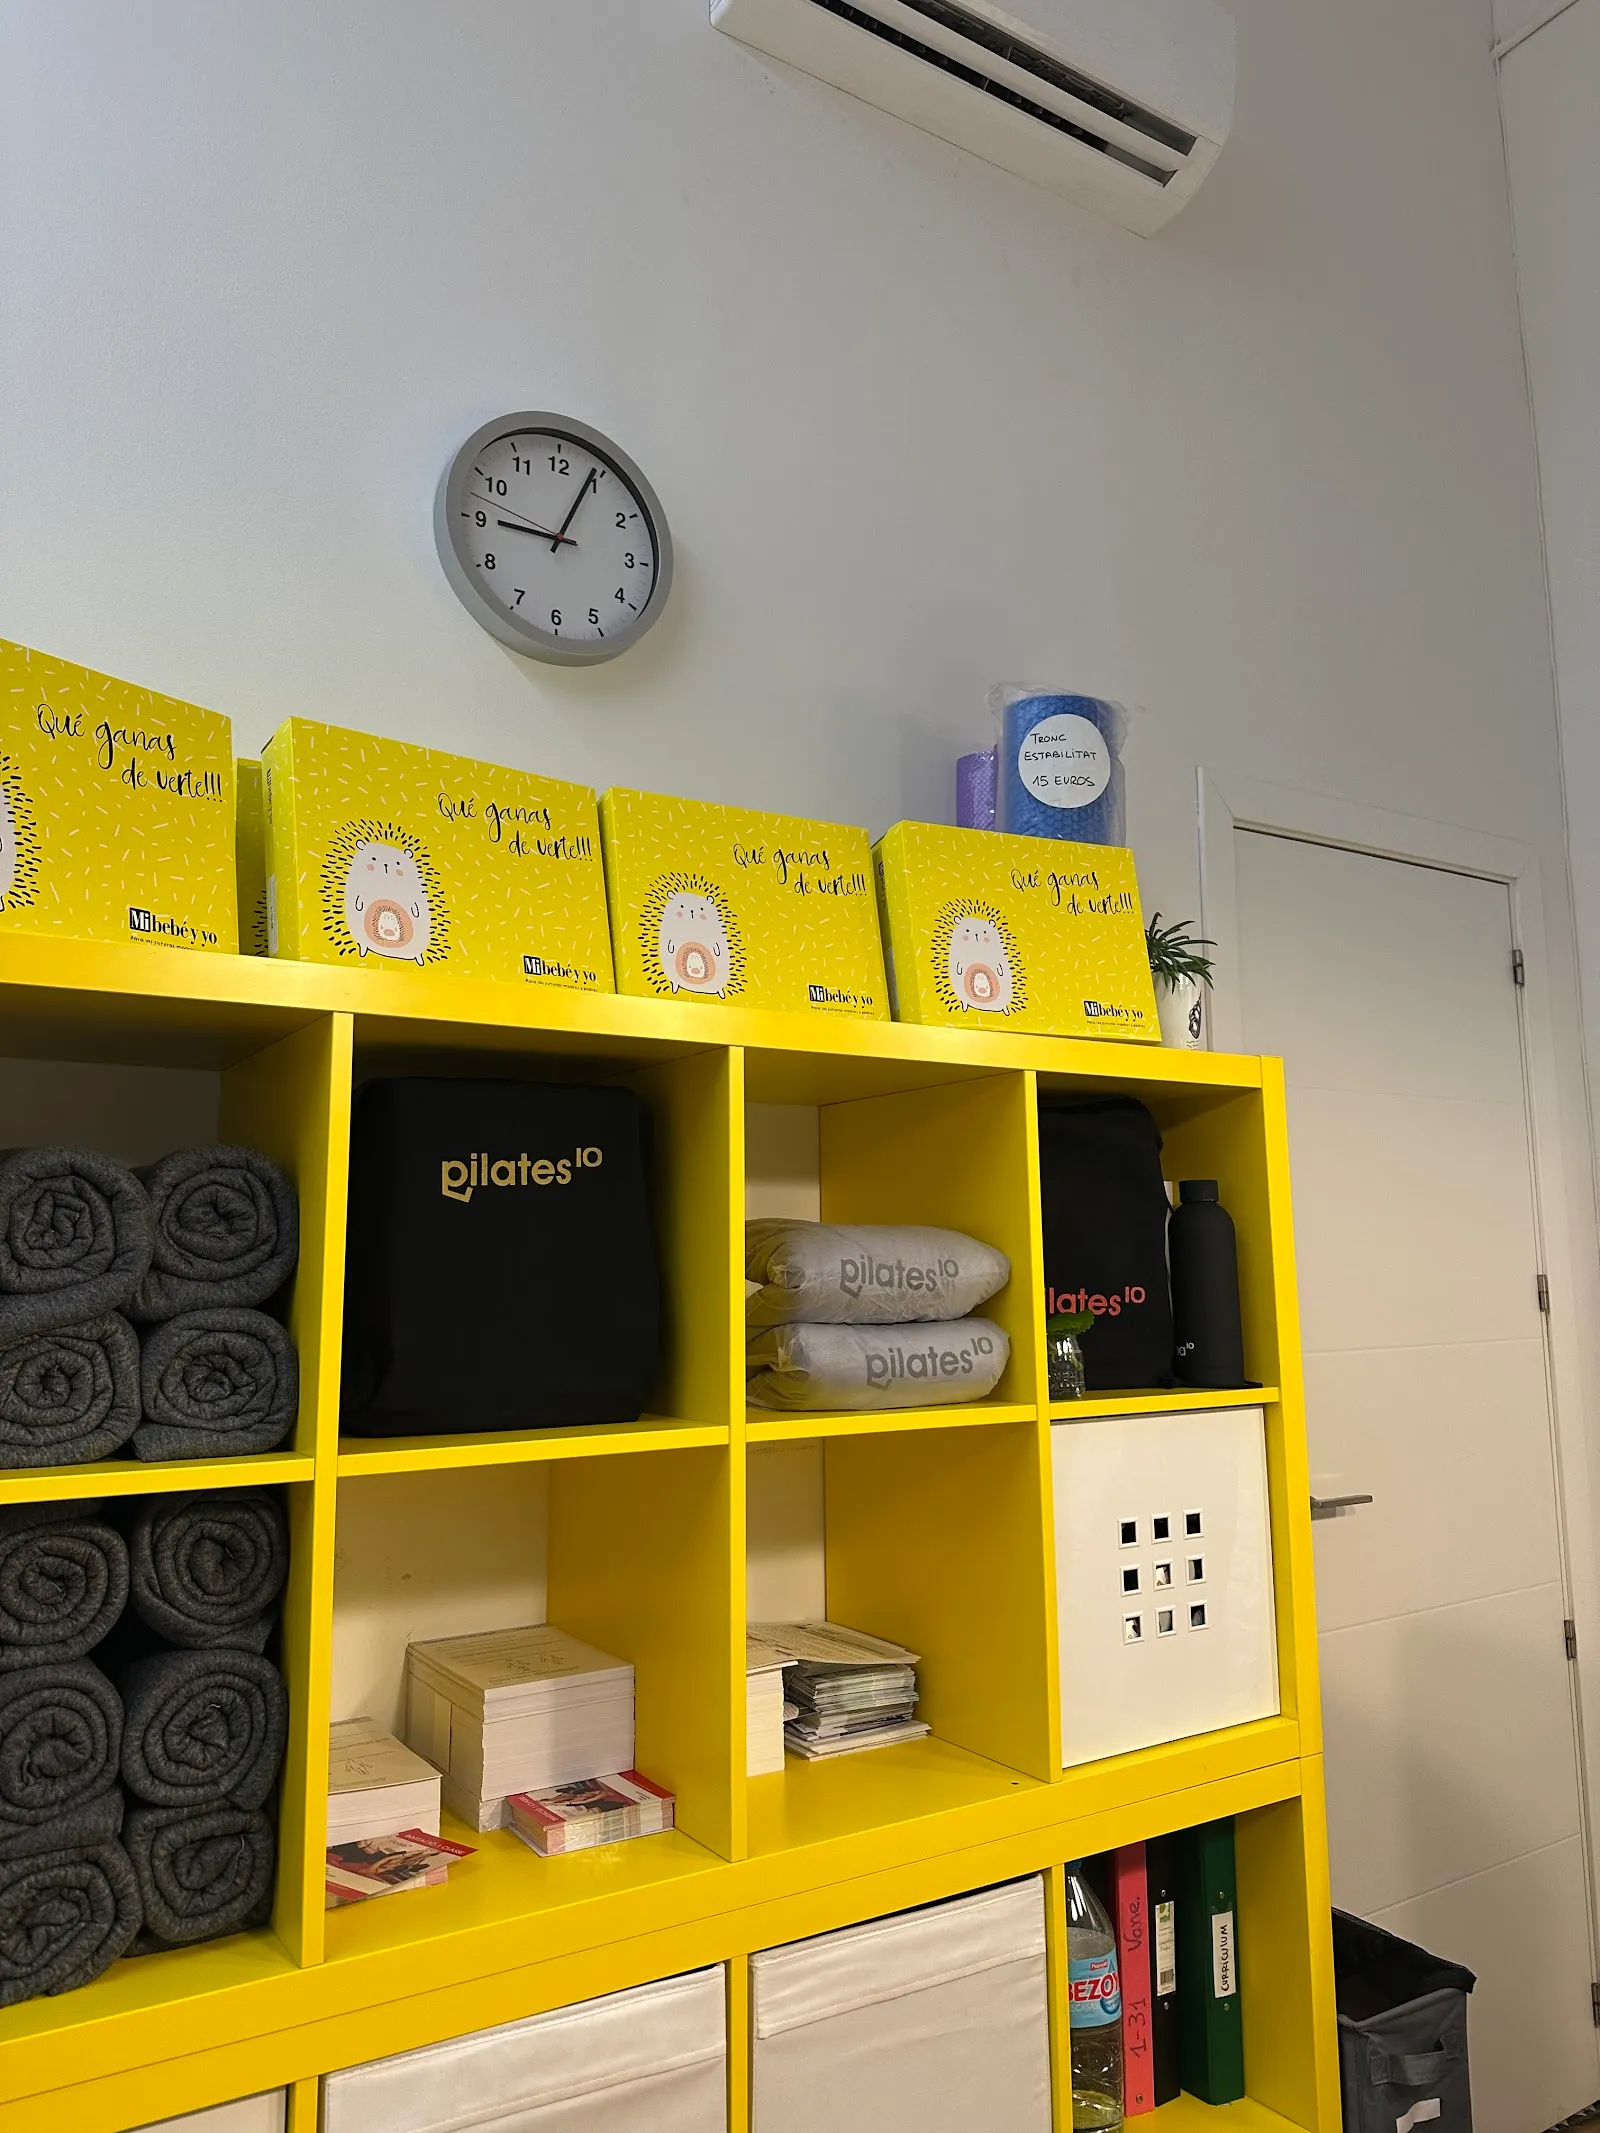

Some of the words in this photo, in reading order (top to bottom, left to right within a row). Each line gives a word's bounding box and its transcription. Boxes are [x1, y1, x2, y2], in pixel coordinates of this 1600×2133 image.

[512, 456, 531, 476] 11
[548, 456, 570, 476] 12
[485, 476, 508, 497] 10
[475, 510, 487, 528] 9
[615, 512, 627, 529] 2
[484, 553, 497, 570] 8
[624, 552, 635, 569] 3
[513, 588, 526, 606] 7
[614, 587, 626, 604] 4
[550, 609, 562, 626] 6
[588, 607, 599, 625] 5
[37, 703, 86, 740] Qué
[95, 720, 177, 770] ganas
[121, 757, 148, 790] de
[156, 770, 223, 803] verte!!!
[1032, 775, 1049, 787] 15
[1054, 775, 1096, 787] EUROS
[437, 792, 478, 822] Qué
[485, 802, 553, 843] ganas
[508, 830, 530, 858] de
[536, 835, 594, 862] verte!!!
[732, 843, 767, 869] Qué
[772, 848, 831, 885] ganas
[794, 872, 812, 897] de
[817, 873, 868, 897] verte!!!
[1010, 868, 1042, 892] Qué
[1047, 870, 1100, 907] ganas
[1066, 895, 1085, 917] de
[1088, 892, 1136, 915] verte!!!
[189, 927, 199, 945] y
[200, 930, 218, 947] yo
[582, 970, 597, 985] yo
[860, 995, 873, 1009] yo
[1131, 1009, 1144, 1022] yo
[1046, 1286, 1146, 1317] lates10
[1129, 1997, 1148, 2058] 1-31
